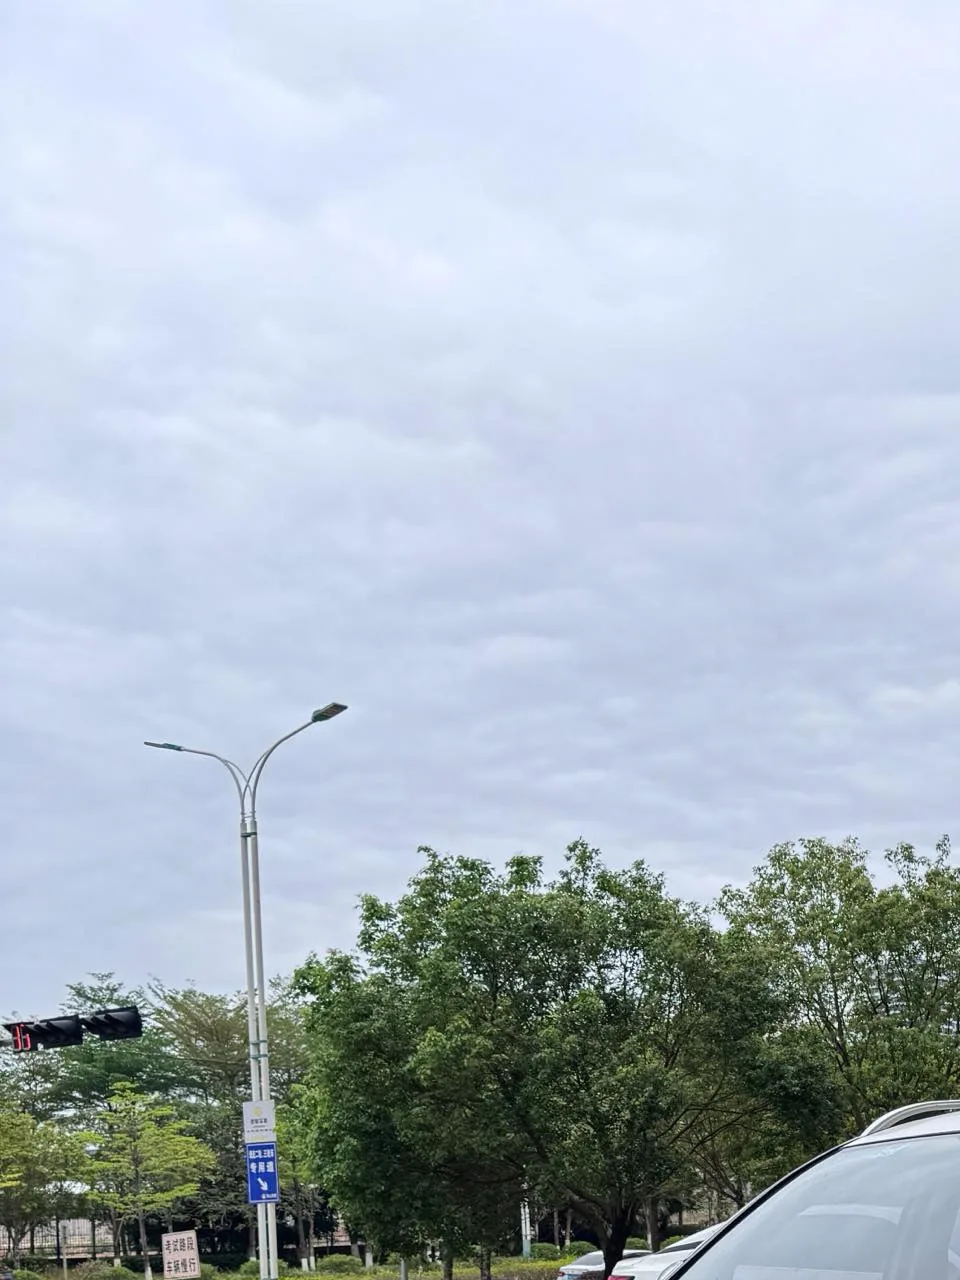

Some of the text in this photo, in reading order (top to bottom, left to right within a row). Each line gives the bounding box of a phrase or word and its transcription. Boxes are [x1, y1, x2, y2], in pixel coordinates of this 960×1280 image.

[165, 1236, 195, 1254] 考试路段
[166, 1257, 196, 1274] 车辆慢行
